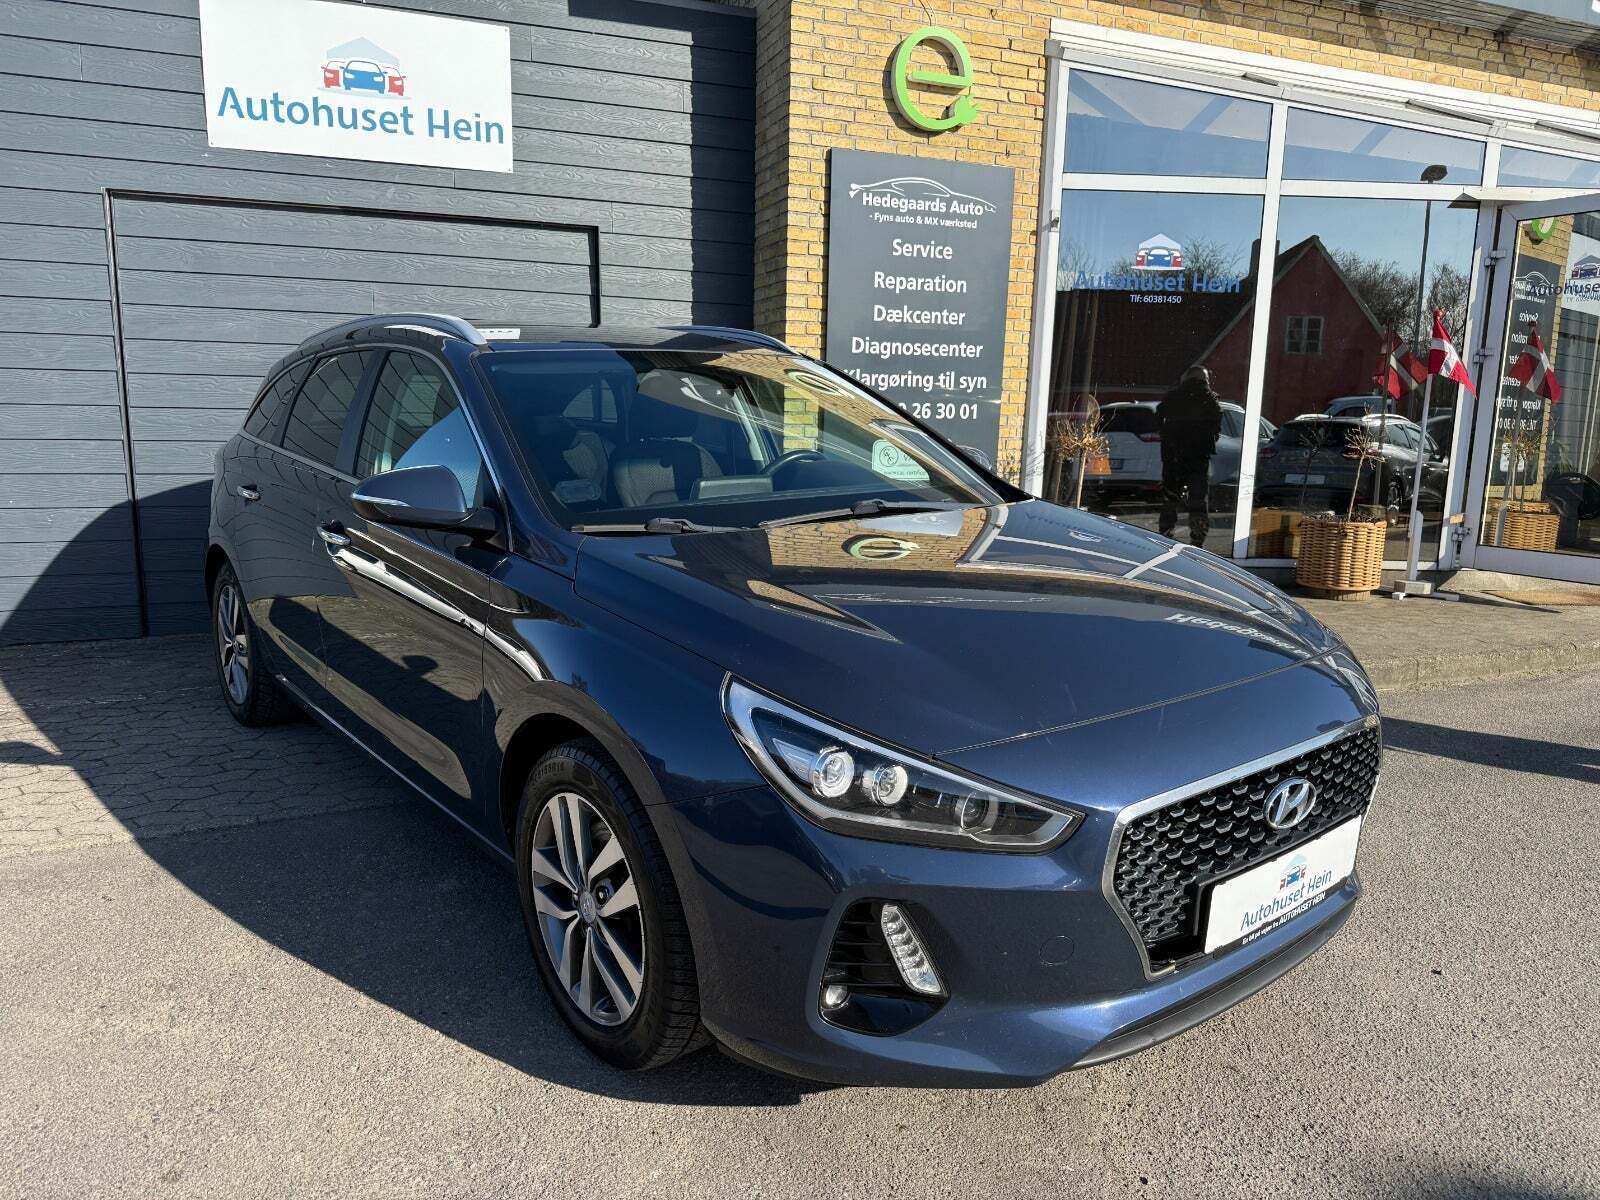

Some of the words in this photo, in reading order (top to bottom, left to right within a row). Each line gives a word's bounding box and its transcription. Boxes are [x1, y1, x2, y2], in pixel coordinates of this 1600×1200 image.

[217, 87, 414, 136] Autohuset
[427, 107, 504, 144] Hein
[862, 192, 947, 213] Hedegaards
[949, 200, 984, 216] Auto
[874, 212, 894, 223] Fyns
[895, 215, 914, 224] auto
[916, 216, 923, 224] &
[924, 216, 939, 225] MX
[892, 238, 953, 260] Service
[874, 271, 967, 293] Reparation
[1074, 271, 1186, 292] Autohuset
[1192, 273, 1241, 293] Hein
[1143, 294, 1182, 304] 60381450
[873, 304, 966, 325] Dækcenter
[851, 336, 984, 359] Diagnosecenter
[938, 371, 956, 391] til
[959, 375, 987, 393] syn
[912, 402, 932, 419] 26
[935, 402, 956, 419] 30
[959, 403, 978, 420] 01
[1240, 882, 1305, 931] Autohuset
[1307, 870, 1332, 894] Hein
[1278, 900, 1311, 925] AUTOHUSET
[1311, 891, 1326, 904] HEIN
